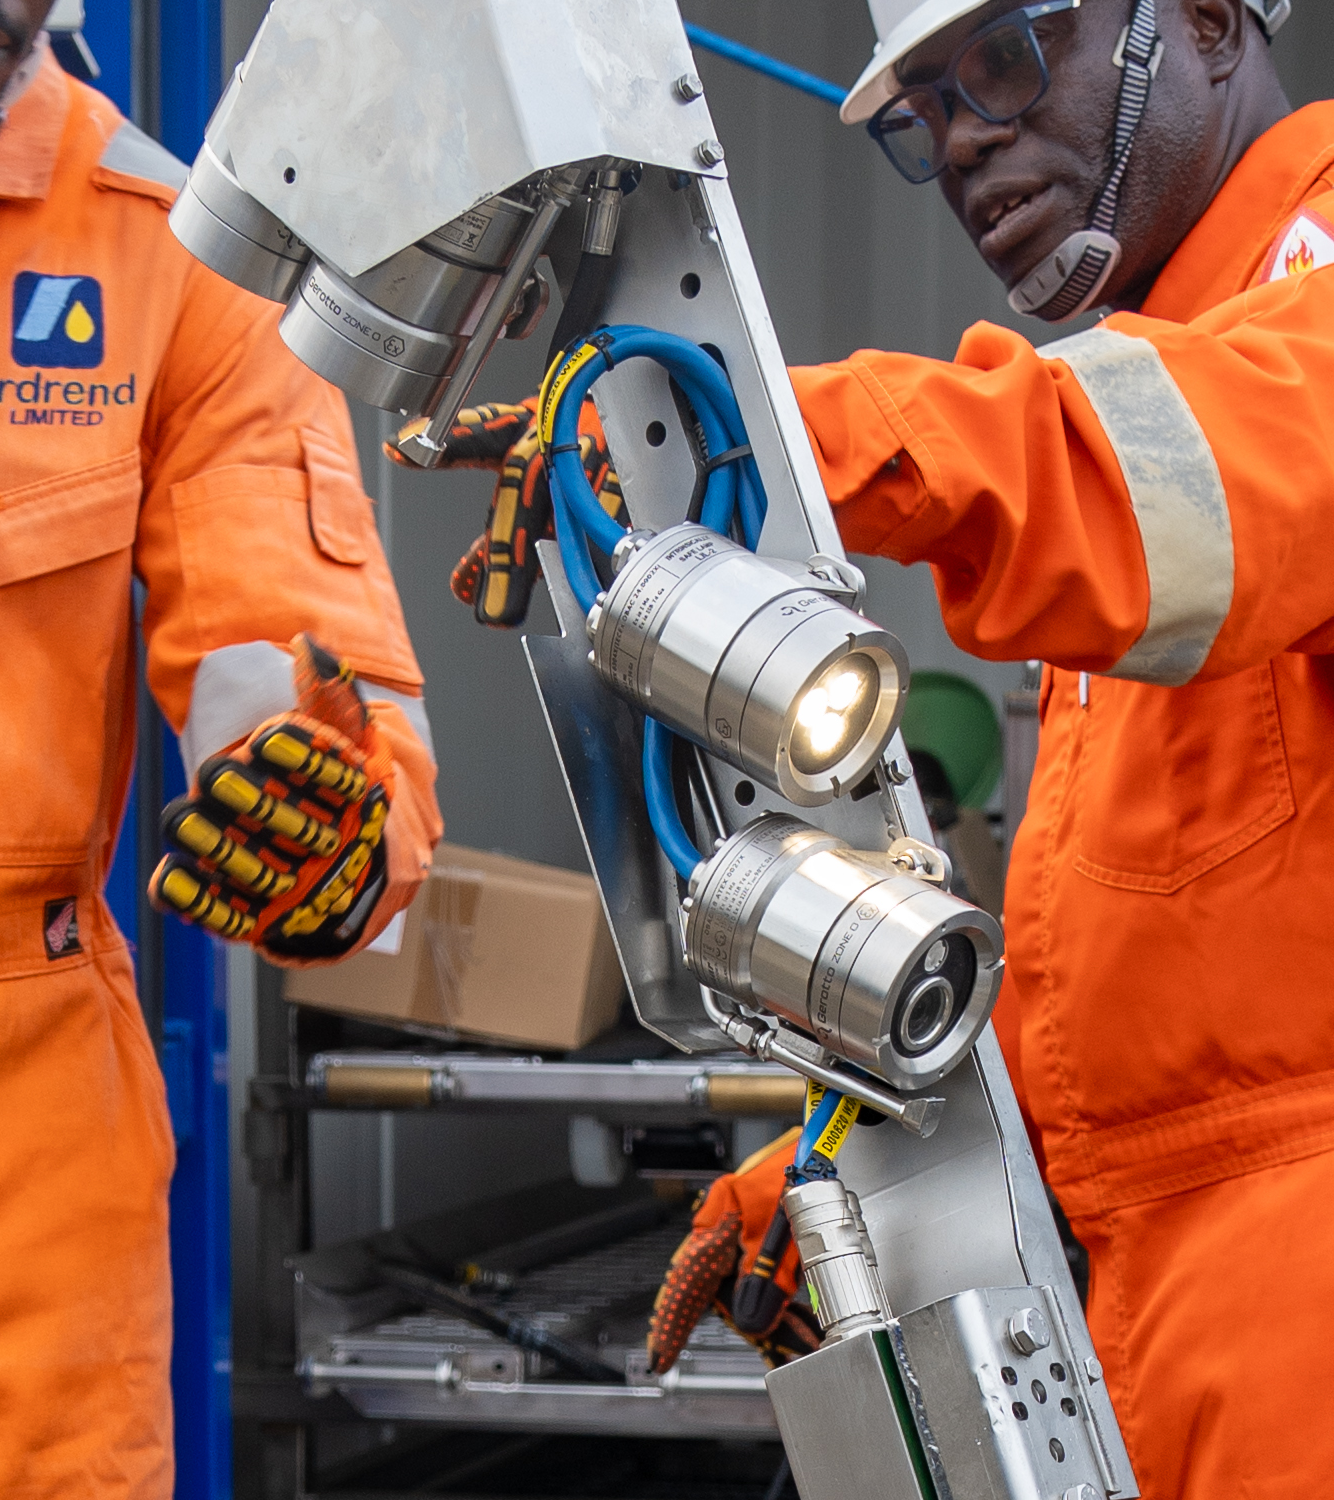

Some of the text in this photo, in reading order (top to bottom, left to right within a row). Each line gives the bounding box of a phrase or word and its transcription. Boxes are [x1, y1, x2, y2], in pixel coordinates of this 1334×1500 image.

[307, 275, 342, 315] Gerotto
[342, 312, 372, 336] ZONE
[10, 409, 103, 426] LIMITED
[715, 878, 728, 899] ATEX
[817, 967, 835, 1024] Gerotto
[832, 932, 850, 963] ZONE
[822, 1114, 848, 1152] D00820
